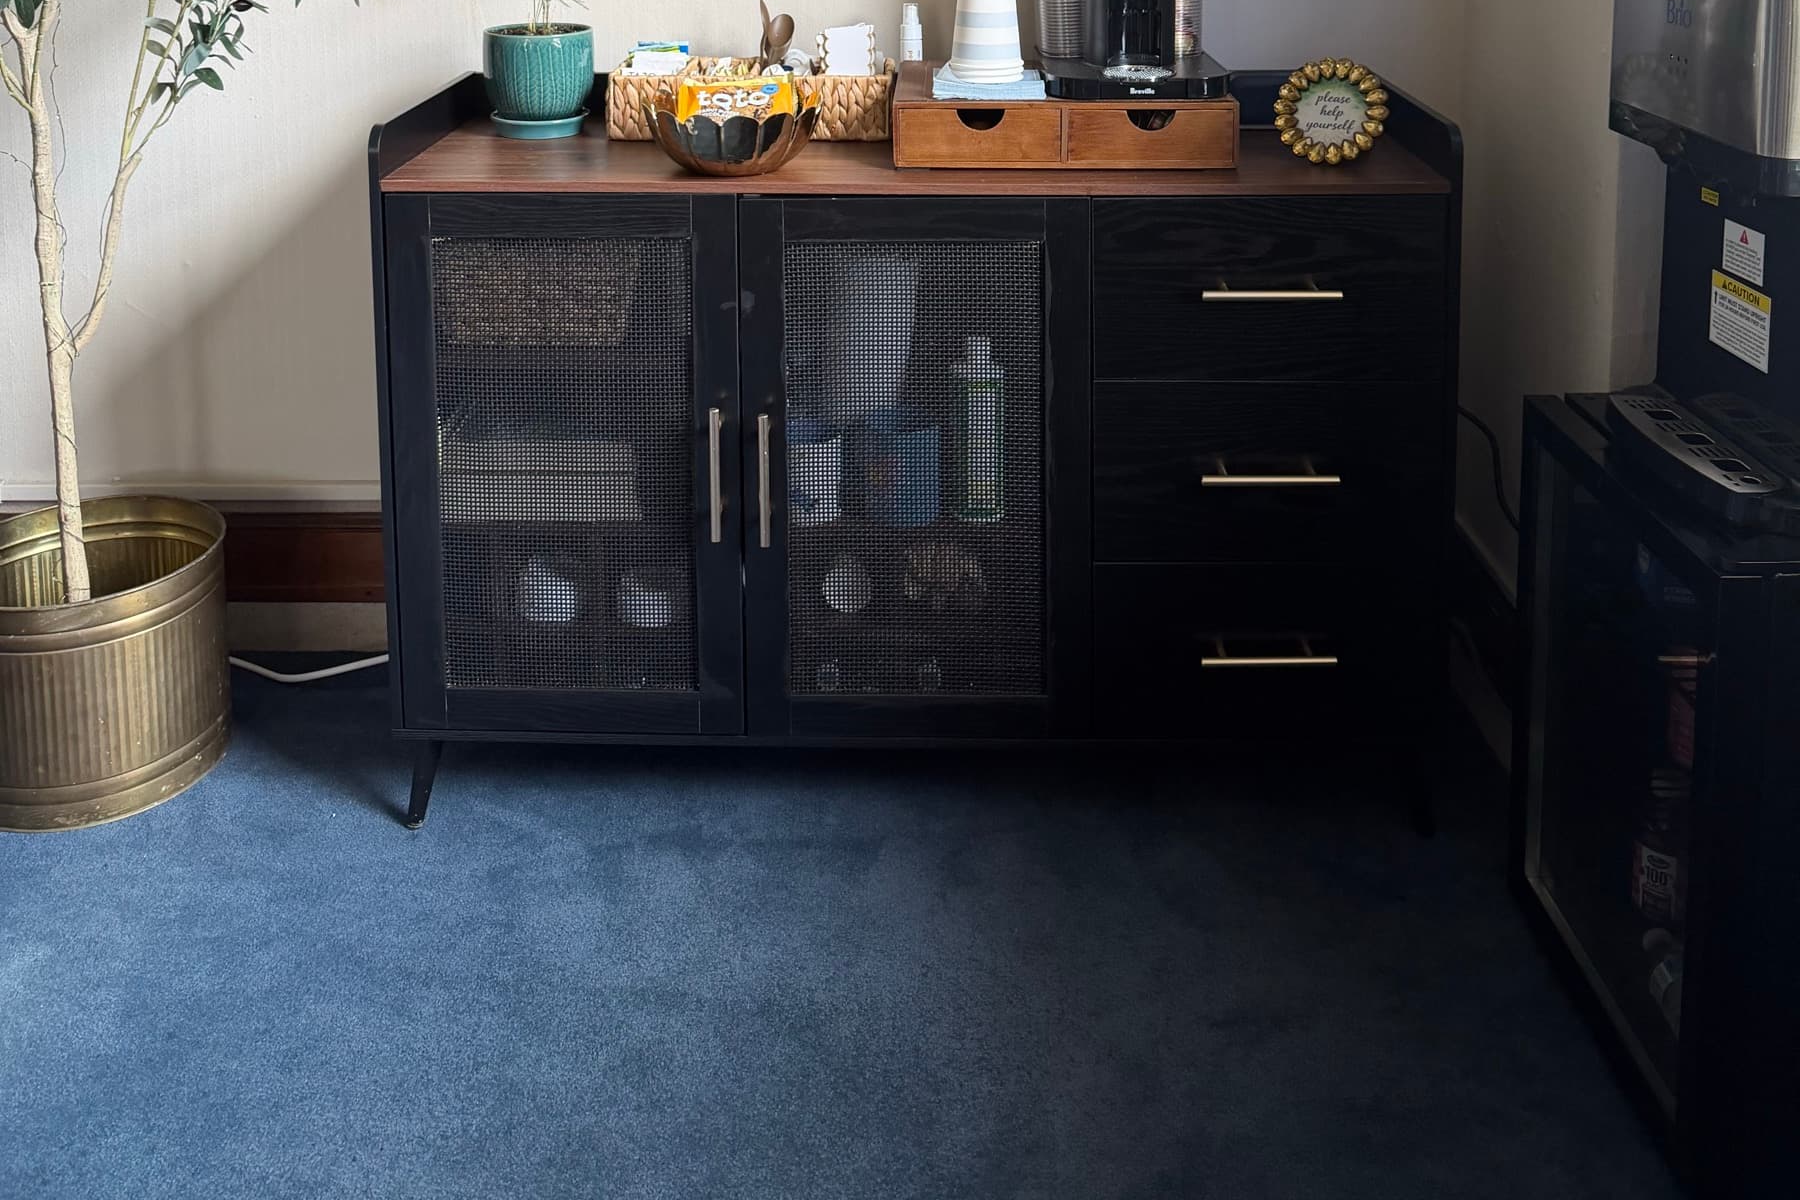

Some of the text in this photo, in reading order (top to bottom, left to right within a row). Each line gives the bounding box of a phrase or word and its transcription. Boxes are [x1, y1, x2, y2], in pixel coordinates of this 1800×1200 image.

[1315, 91, 1351, 106] please
[1319, 104, 1344, 121] help
[1304, 119, 1355, 134] yourself
[1727, 281, 1760, 307] CAUTION
